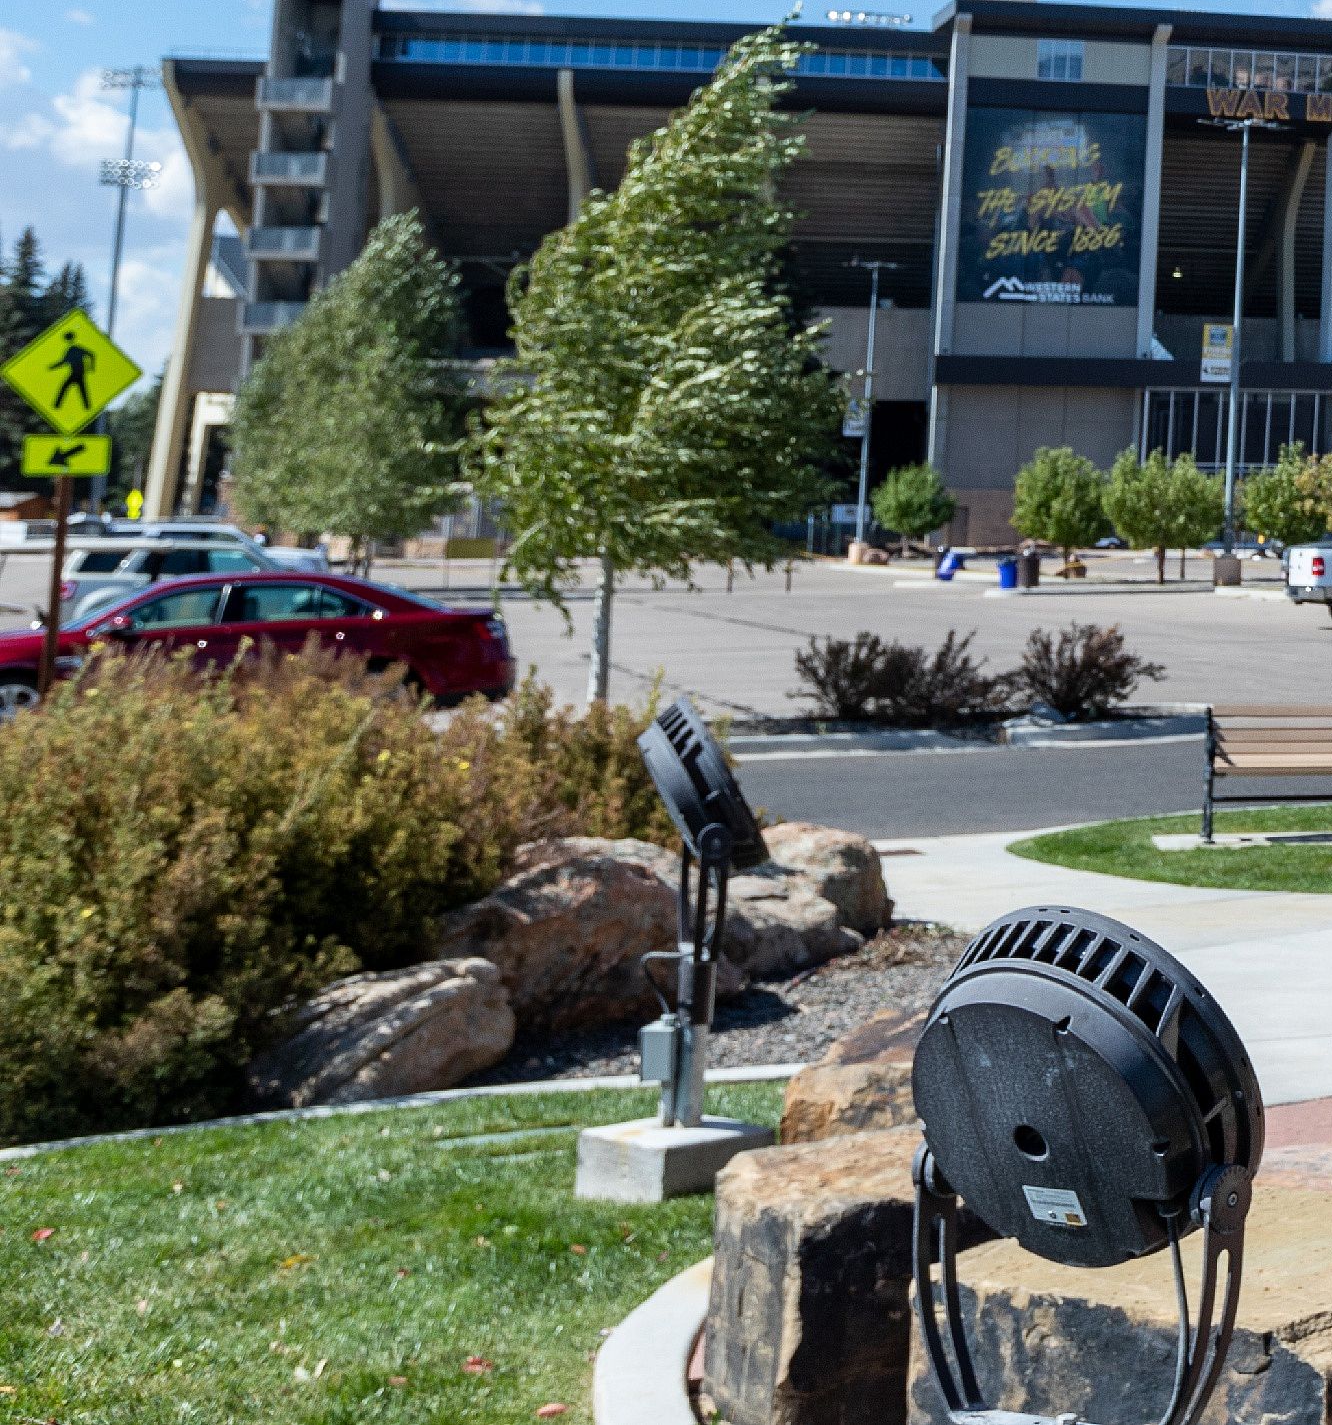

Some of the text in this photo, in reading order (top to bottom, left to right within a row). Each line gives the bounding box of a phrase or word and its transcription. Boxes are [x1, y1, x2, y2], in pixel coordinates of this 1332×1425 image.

[1207, 88, 1290, 120] WAR
[977, 181, 1123, 222] THE SYSTEM
[986, 224, 1124, 259] SINCE 1886.
[1022, 282, 1081, 293] WESTERN
[1036, 293, 1115, 304] STATES BANK
